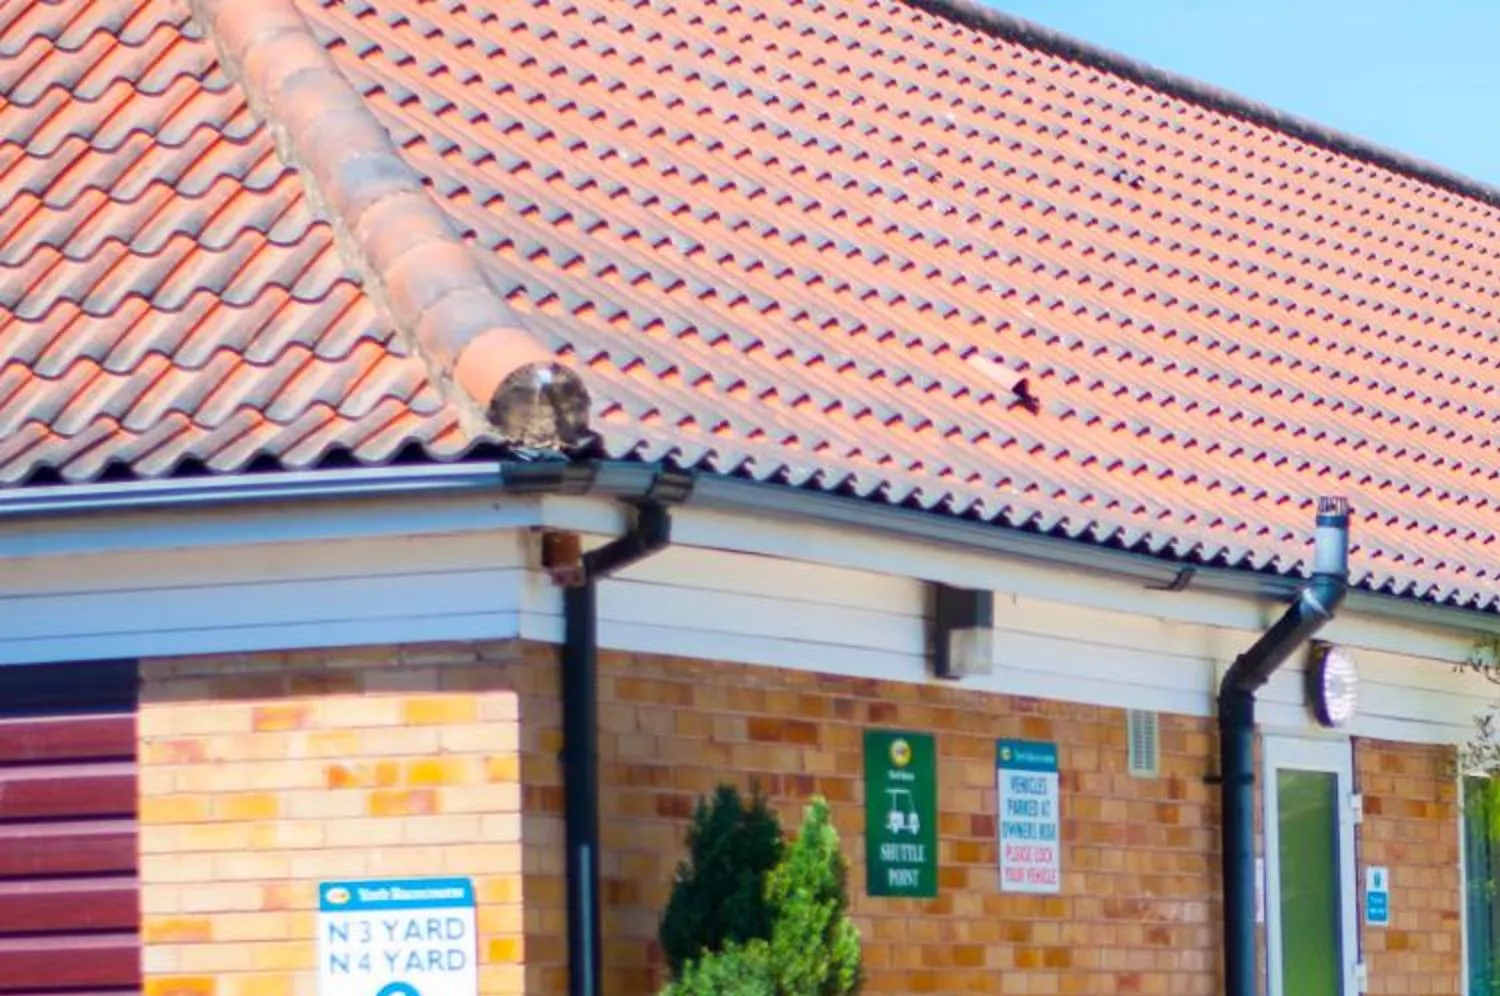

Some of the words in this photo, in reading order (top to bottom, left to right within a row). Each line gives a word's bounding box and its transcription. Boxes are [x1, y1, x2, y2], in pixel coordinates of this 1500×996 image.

[1008, 798, 1038, 817] PARKED
[880, 844, 925, 863] SHUTTLE
[888, 868, 919, 888] POINT
[382, 917, 466, 942] YARD
[383, 949, 467, 974] YARD
